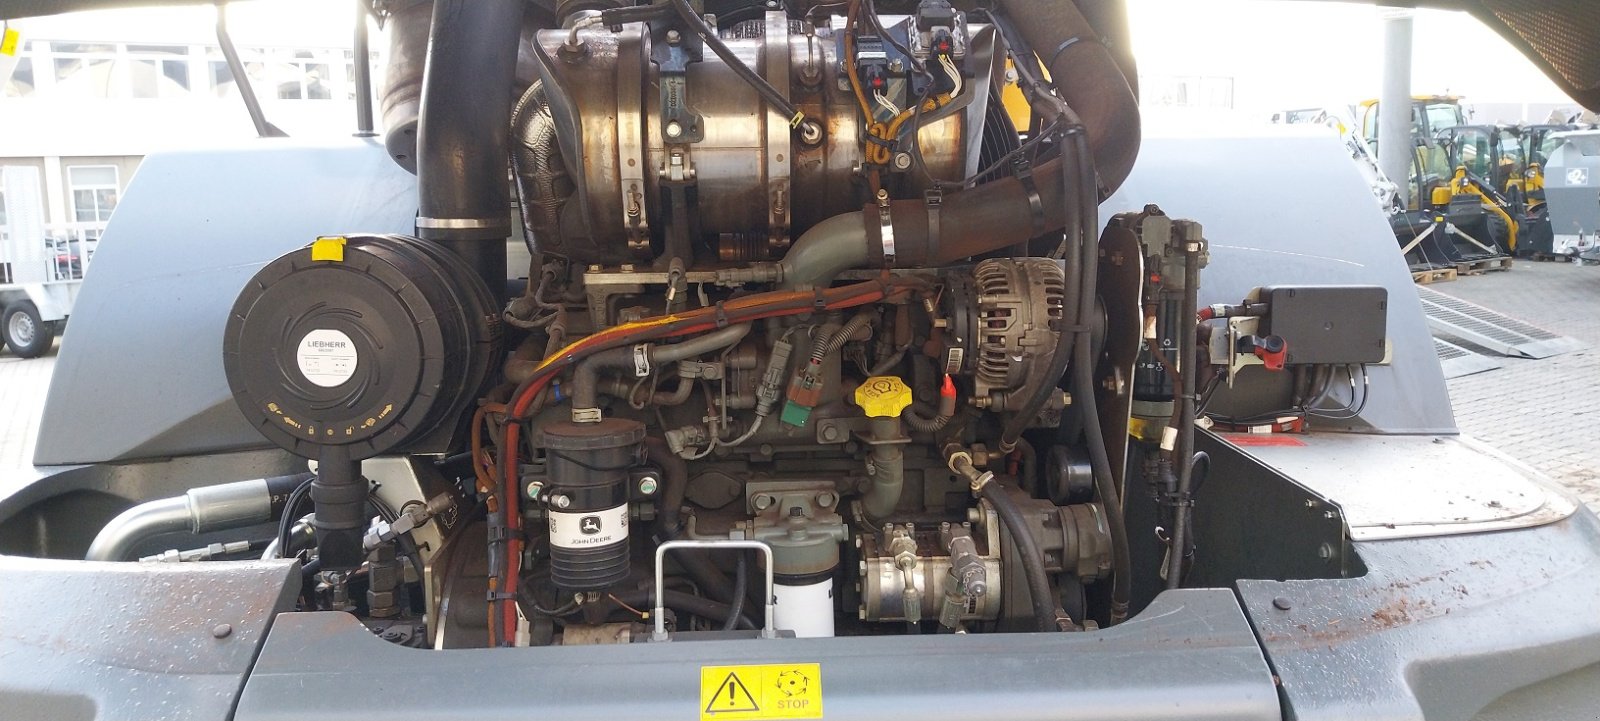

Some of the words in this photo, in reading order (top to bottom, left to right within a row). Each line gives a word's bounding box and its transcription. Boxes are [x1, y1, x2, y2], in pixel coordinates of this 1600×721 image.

[307, 340, 346, 348] LIEBHERR
[590, 535, 612, 544] DEERE
[777, 699, 809, 709] STOP
